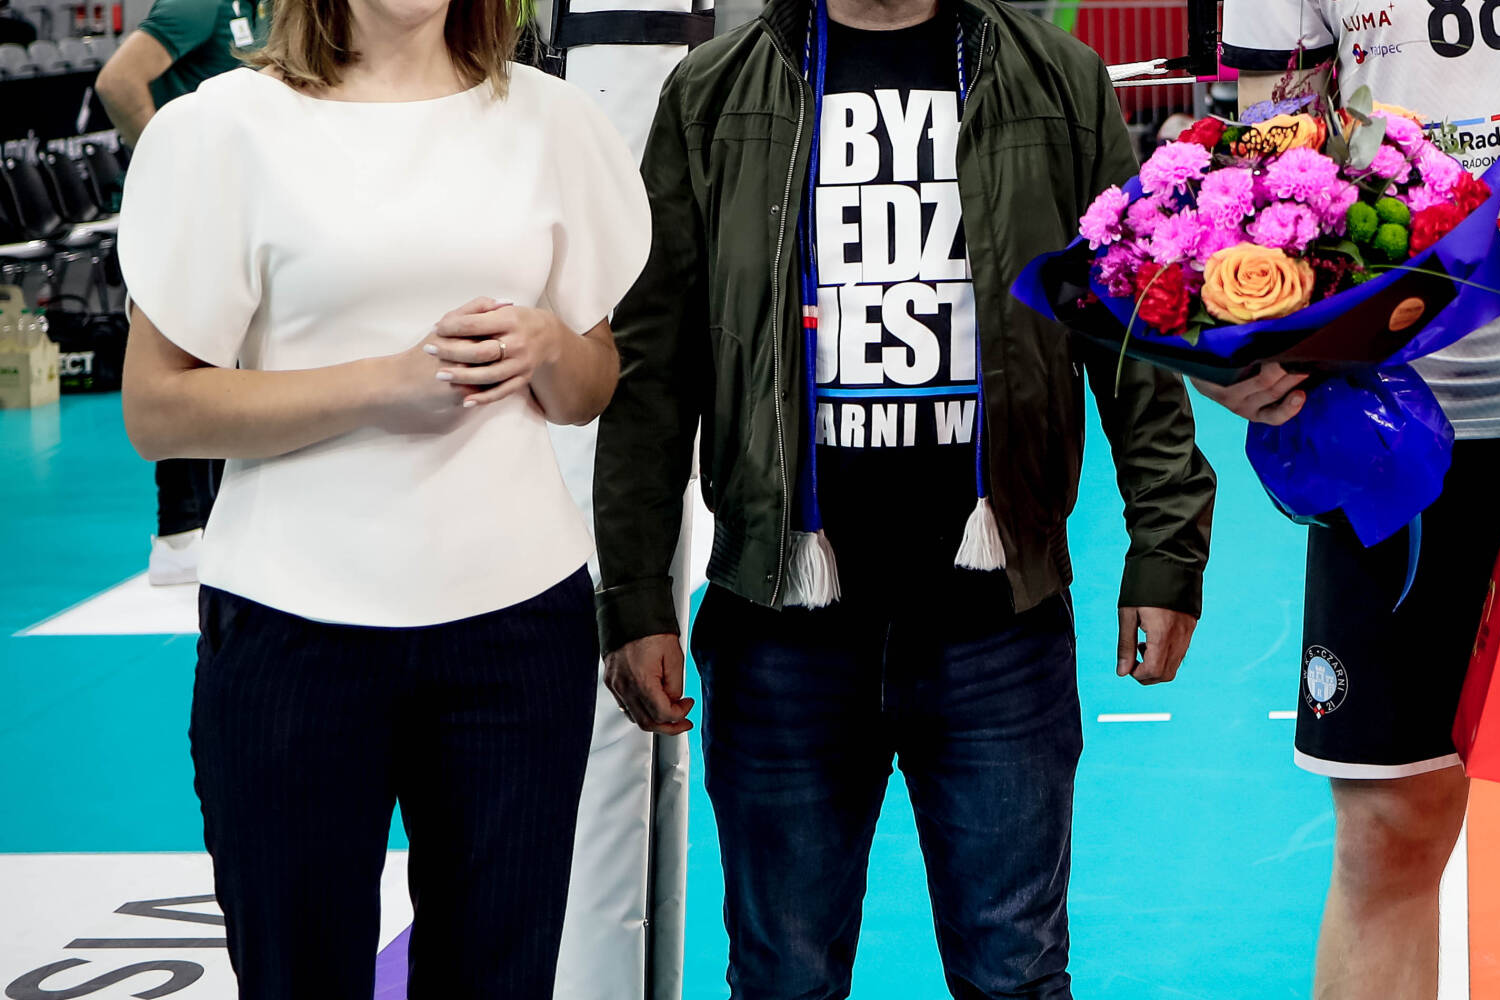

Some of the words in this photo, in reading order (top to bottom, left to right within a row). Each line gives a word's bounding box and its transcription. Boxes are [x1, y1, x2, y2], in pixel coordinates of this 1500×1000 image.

[816, 281, 976, 385] JEST
[58, 351, 95, 375] ECT
[816, 402, 917, 448] ARNI
[1321, 650, 1345, 691] CZARNI
